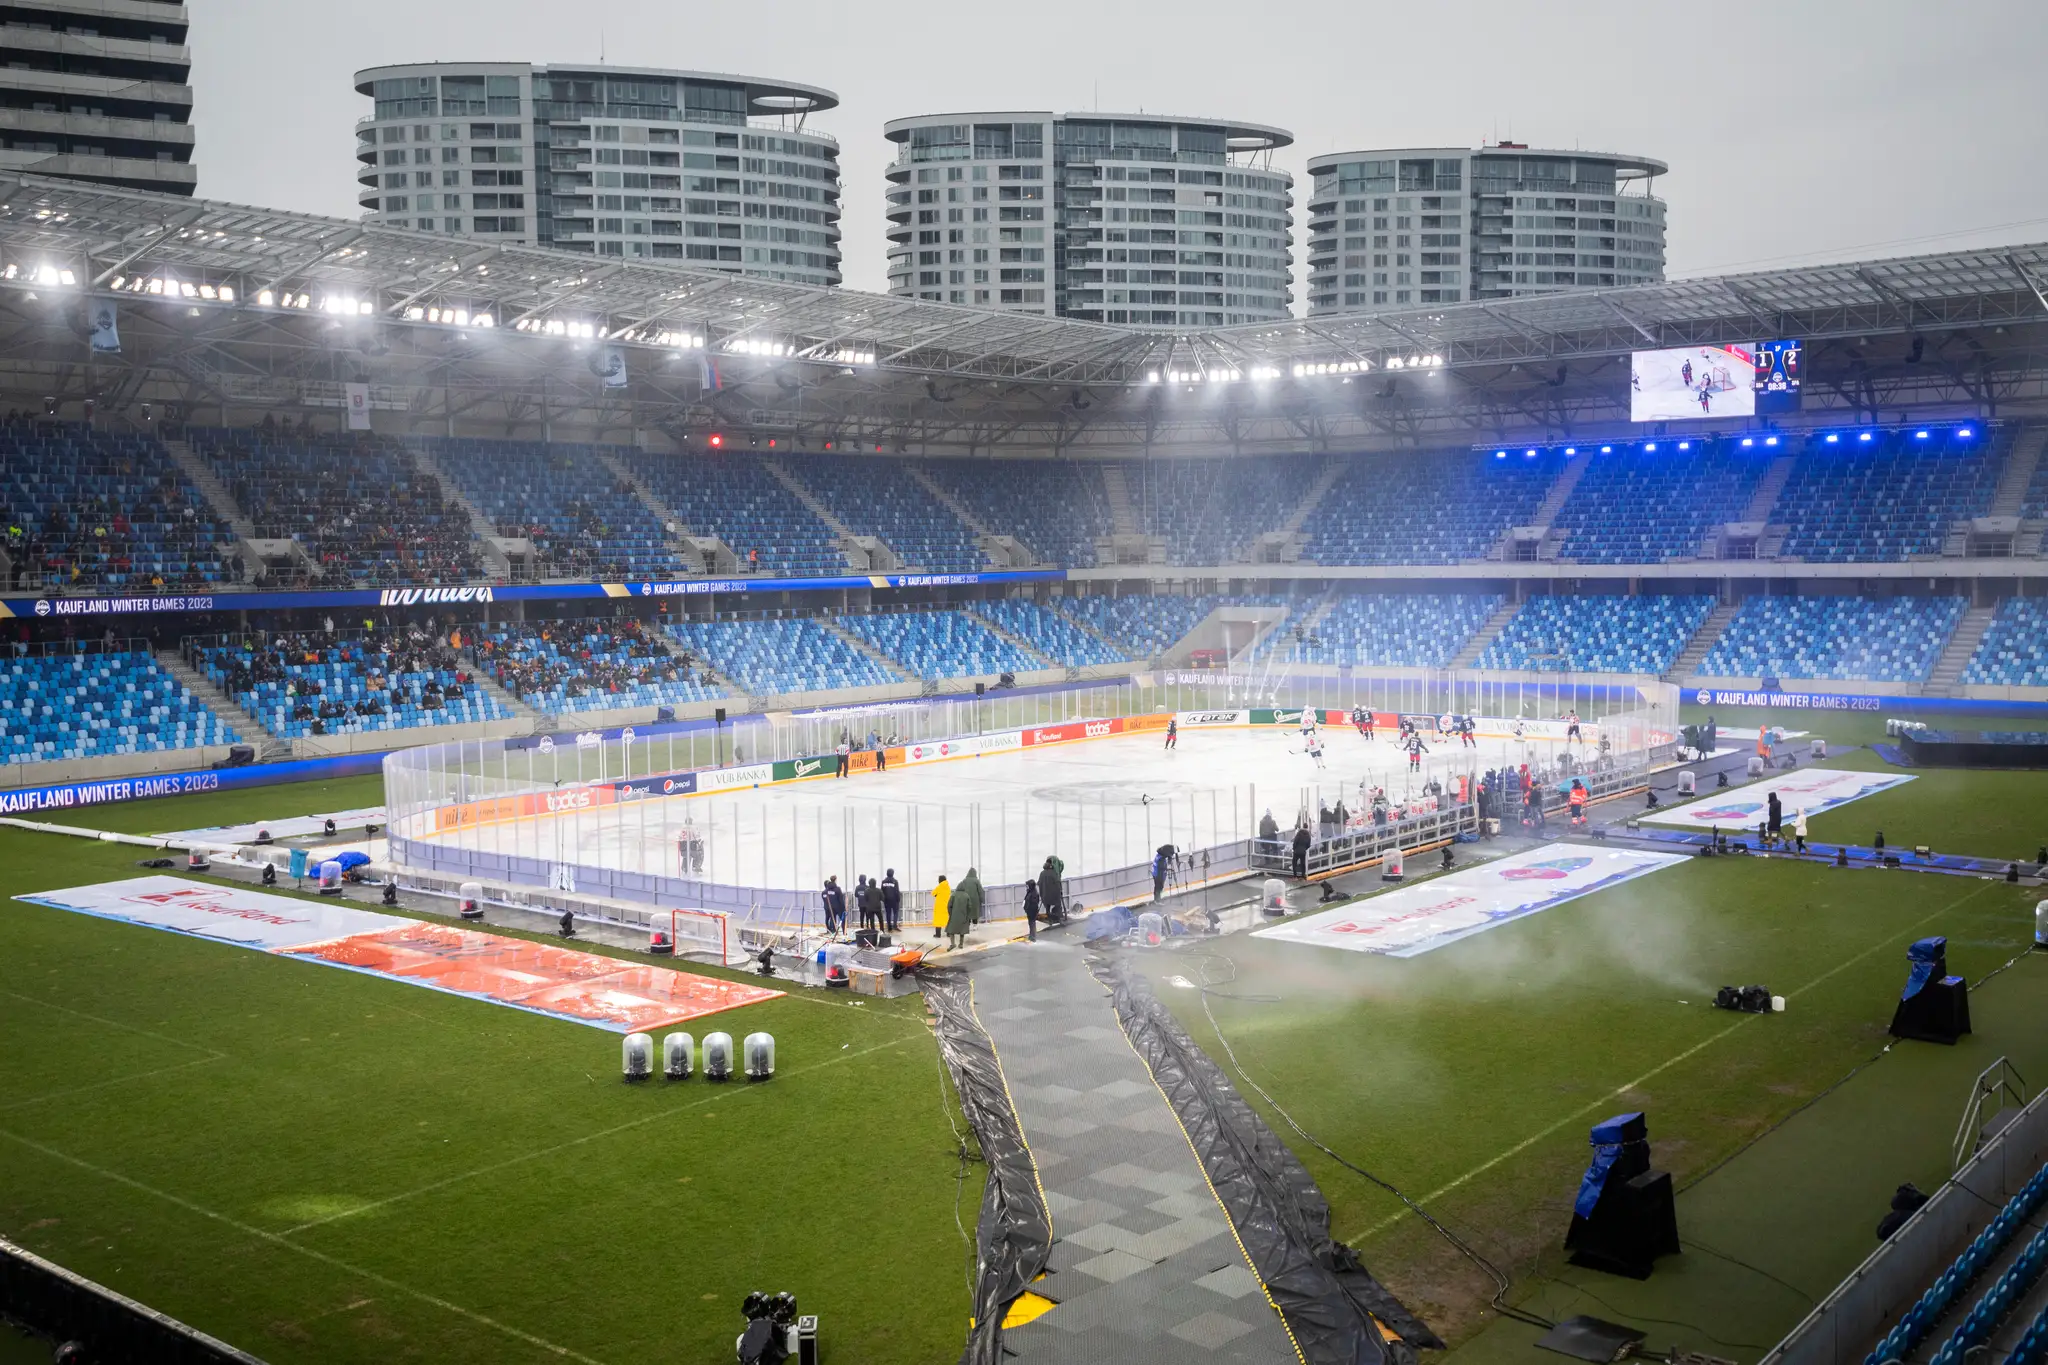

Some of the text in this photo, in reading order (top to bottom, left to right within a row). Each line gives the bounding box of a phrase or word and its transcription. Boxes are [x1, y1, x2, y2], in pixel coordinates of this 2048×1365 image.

[1760, 353, 1767, 367] 1
[1788, 351, 1796, 365] 2
[907, 575, 978, 586] KAUFLAND WINTER GAMES 2023
[654, 582, 747, 595] KAUFLAND WINTER GAMES 2023
[56, 597, 213, 614] KAUFLAND WINTER GAMES 2023
[1716, 692, 1880, 710] KAUFLAND WINTER GAMES 2023
[736, 769, 767, 782] BANKA
[633, 786, 650, 794] pepsi
[674, 780, 691, 789] pepsi
[0, 773, 218, 813] KAUFLAND WINTER GAMES 2023
